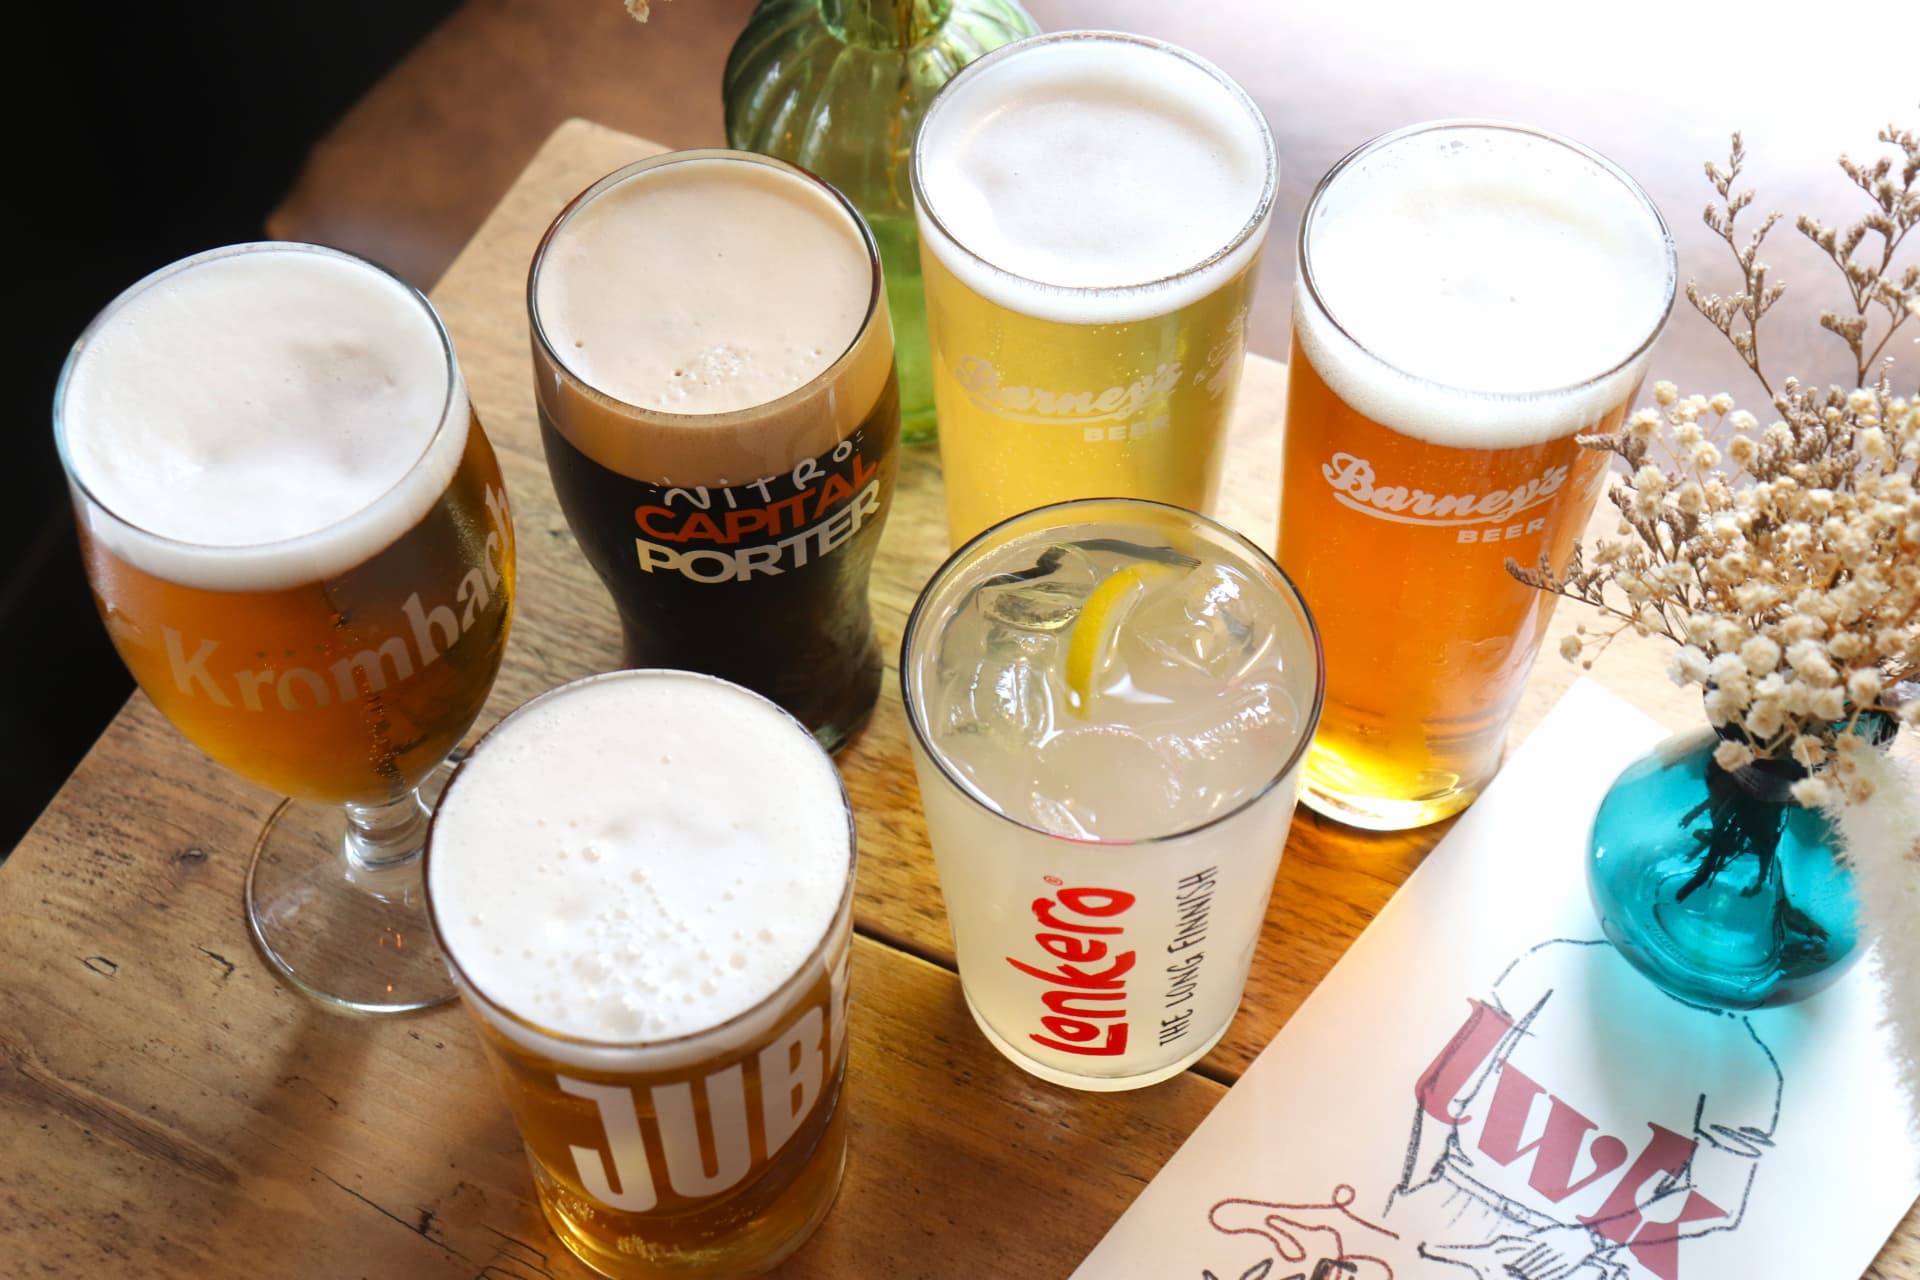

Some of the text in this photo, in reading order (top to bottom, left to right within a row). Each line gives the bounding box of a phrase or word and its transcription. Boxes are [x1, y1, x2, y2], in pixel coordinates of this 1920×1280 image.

[634, 454, 878, 544] CAPITAL
[635, 479, 881, 584] PORTER
[1321, 452, 1568, 522] Barney's
[1456, 518, 1546, 544] BEER
[1158, 865, 1219, 1048] THE LONG FINNISH
